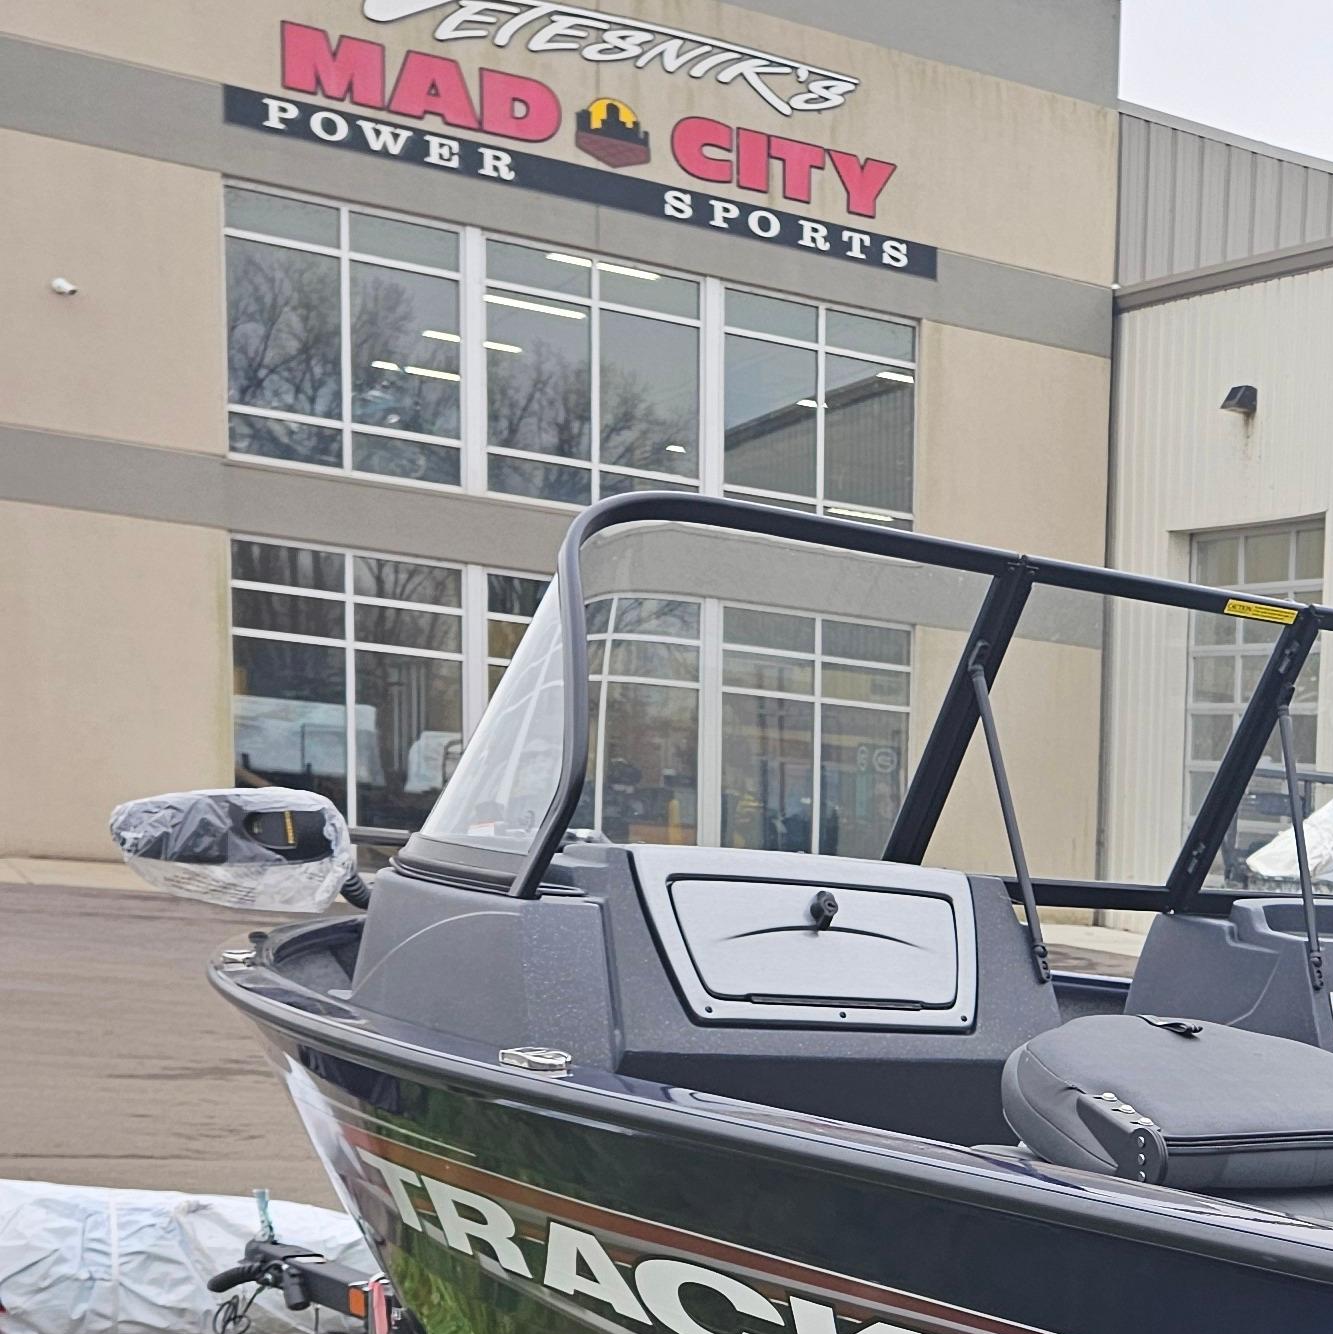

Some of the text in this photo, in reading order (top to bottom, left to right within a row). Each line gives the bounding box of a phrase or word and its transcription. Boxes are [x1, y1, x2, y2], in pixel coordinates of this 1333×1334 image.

[262, 99, 910, 268] POWER SPORTS
[281, 20, 897, 218] MAD CITY
